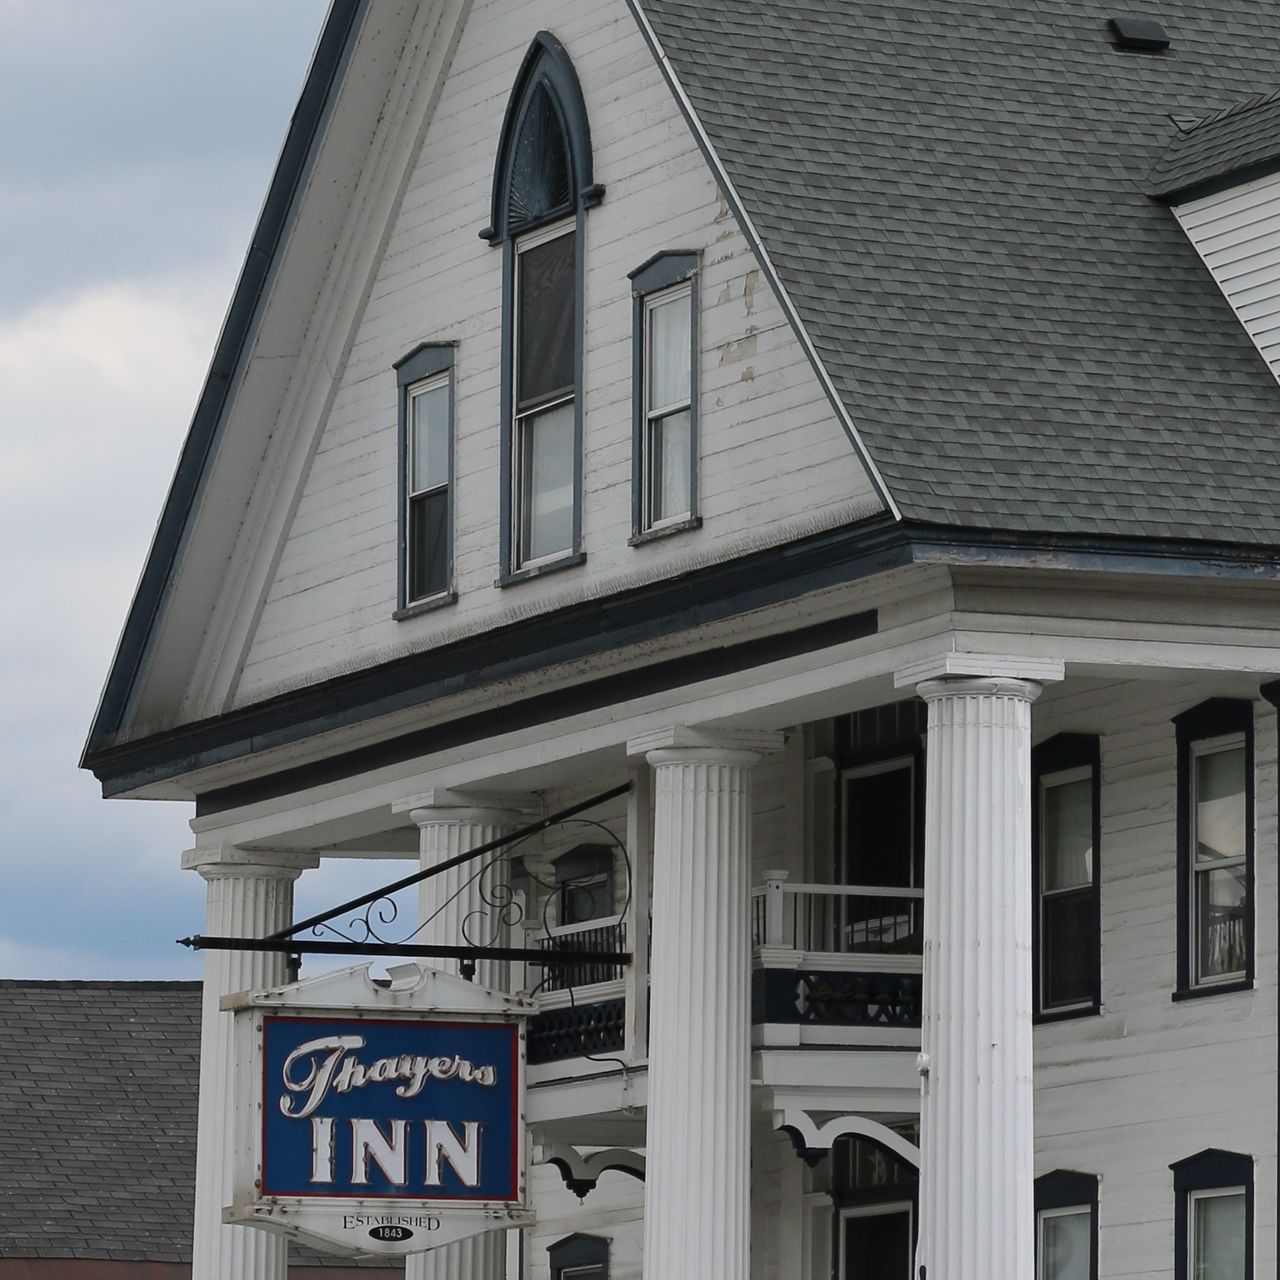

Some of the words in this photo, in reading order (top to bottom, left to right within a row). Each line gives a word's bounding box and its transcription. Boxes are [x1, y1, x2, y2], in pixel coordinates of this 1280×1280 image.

[279, 1035, 498, 1118] Thayers
[309, 1117, 484, 1187] INN
[343, 1215, 441, 1231] ESTABLISHED
[378, 1228, 403, 1238] 1843
